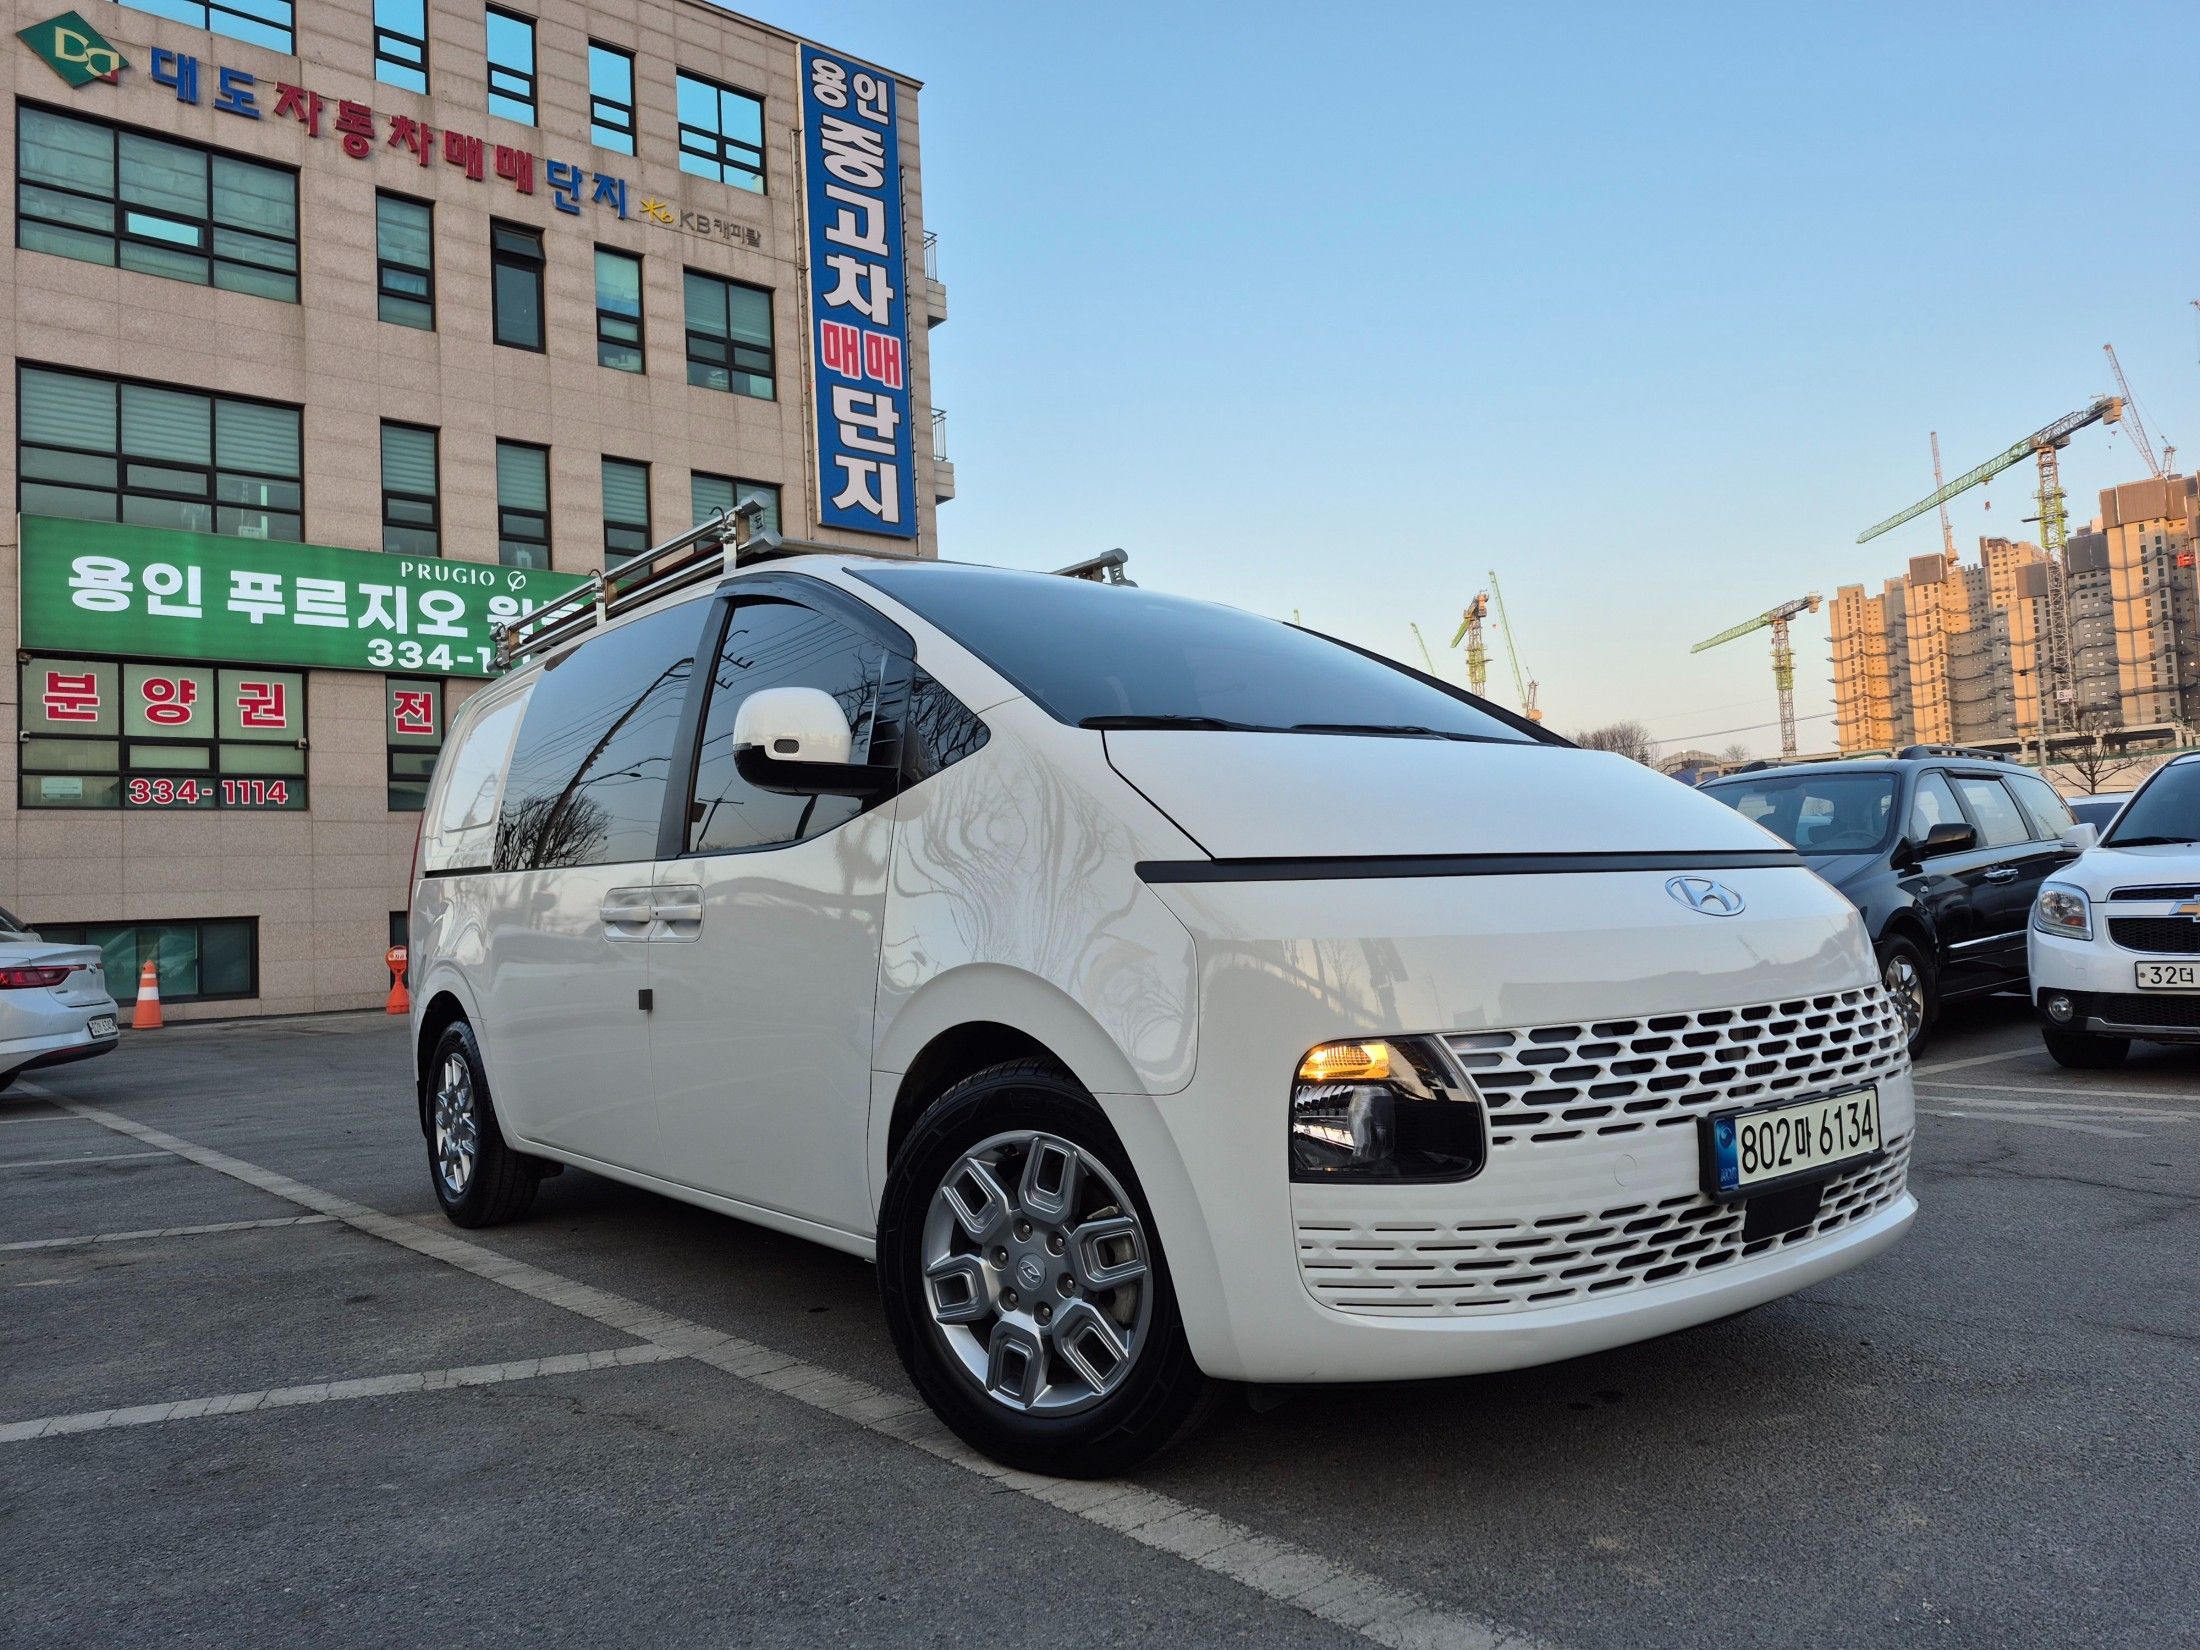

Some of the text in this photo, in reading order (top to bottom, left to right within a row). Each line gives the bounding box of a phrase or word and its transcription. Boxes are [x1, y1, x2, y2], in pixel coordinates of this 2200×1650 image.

[811, 57, 889, 126] 용인
[69, 555, 203, 618] 용인
[227, 568, 469, 638] 푸르지오
[401, 561, 495, 587] PRUGIO
[2150, 965, 2194, 985] 32더
[1819, 1098, 1874, 1156] 6134
